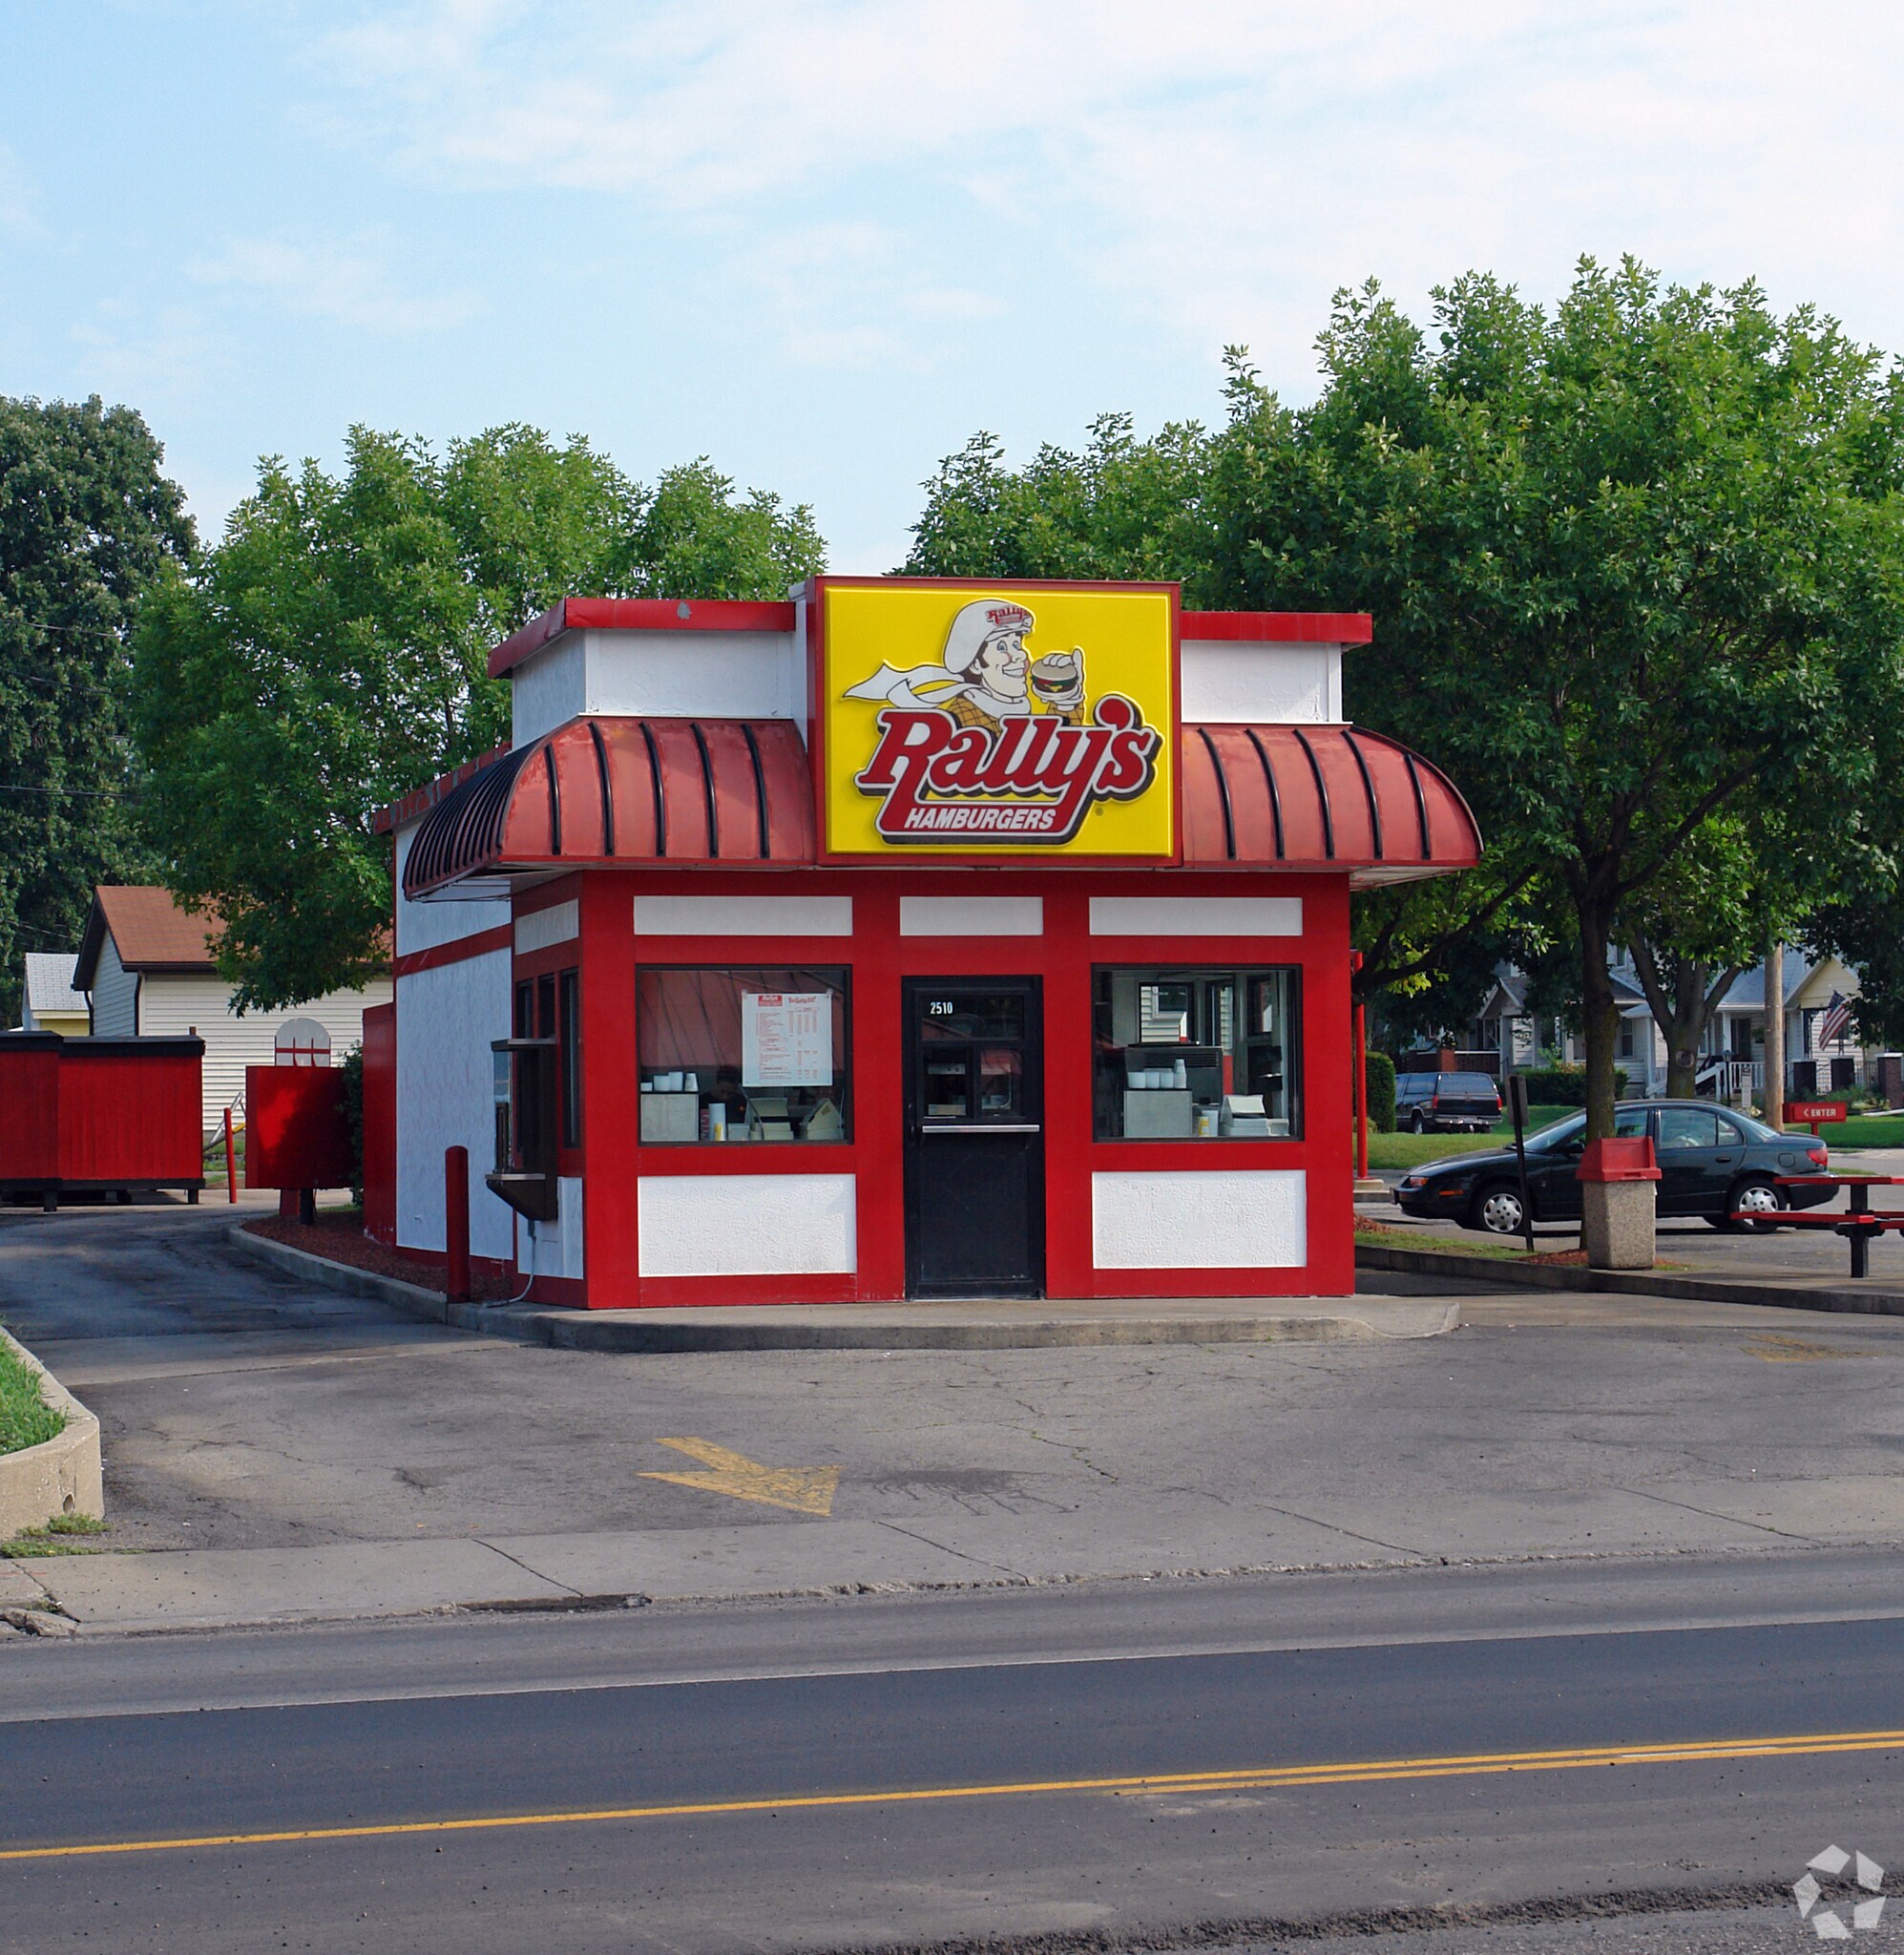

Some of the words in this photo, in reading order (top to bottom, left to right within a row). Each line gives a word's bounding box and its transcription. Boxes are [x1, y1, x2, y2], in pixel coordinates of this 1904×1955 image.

[856, 696, 1154, 831] Rally's
[904, 808, 1057, 830] HAMBURGERS
[930, 1001, 953, 1015] 2510
[1810, 1108, 1837, 1118] ENTER
